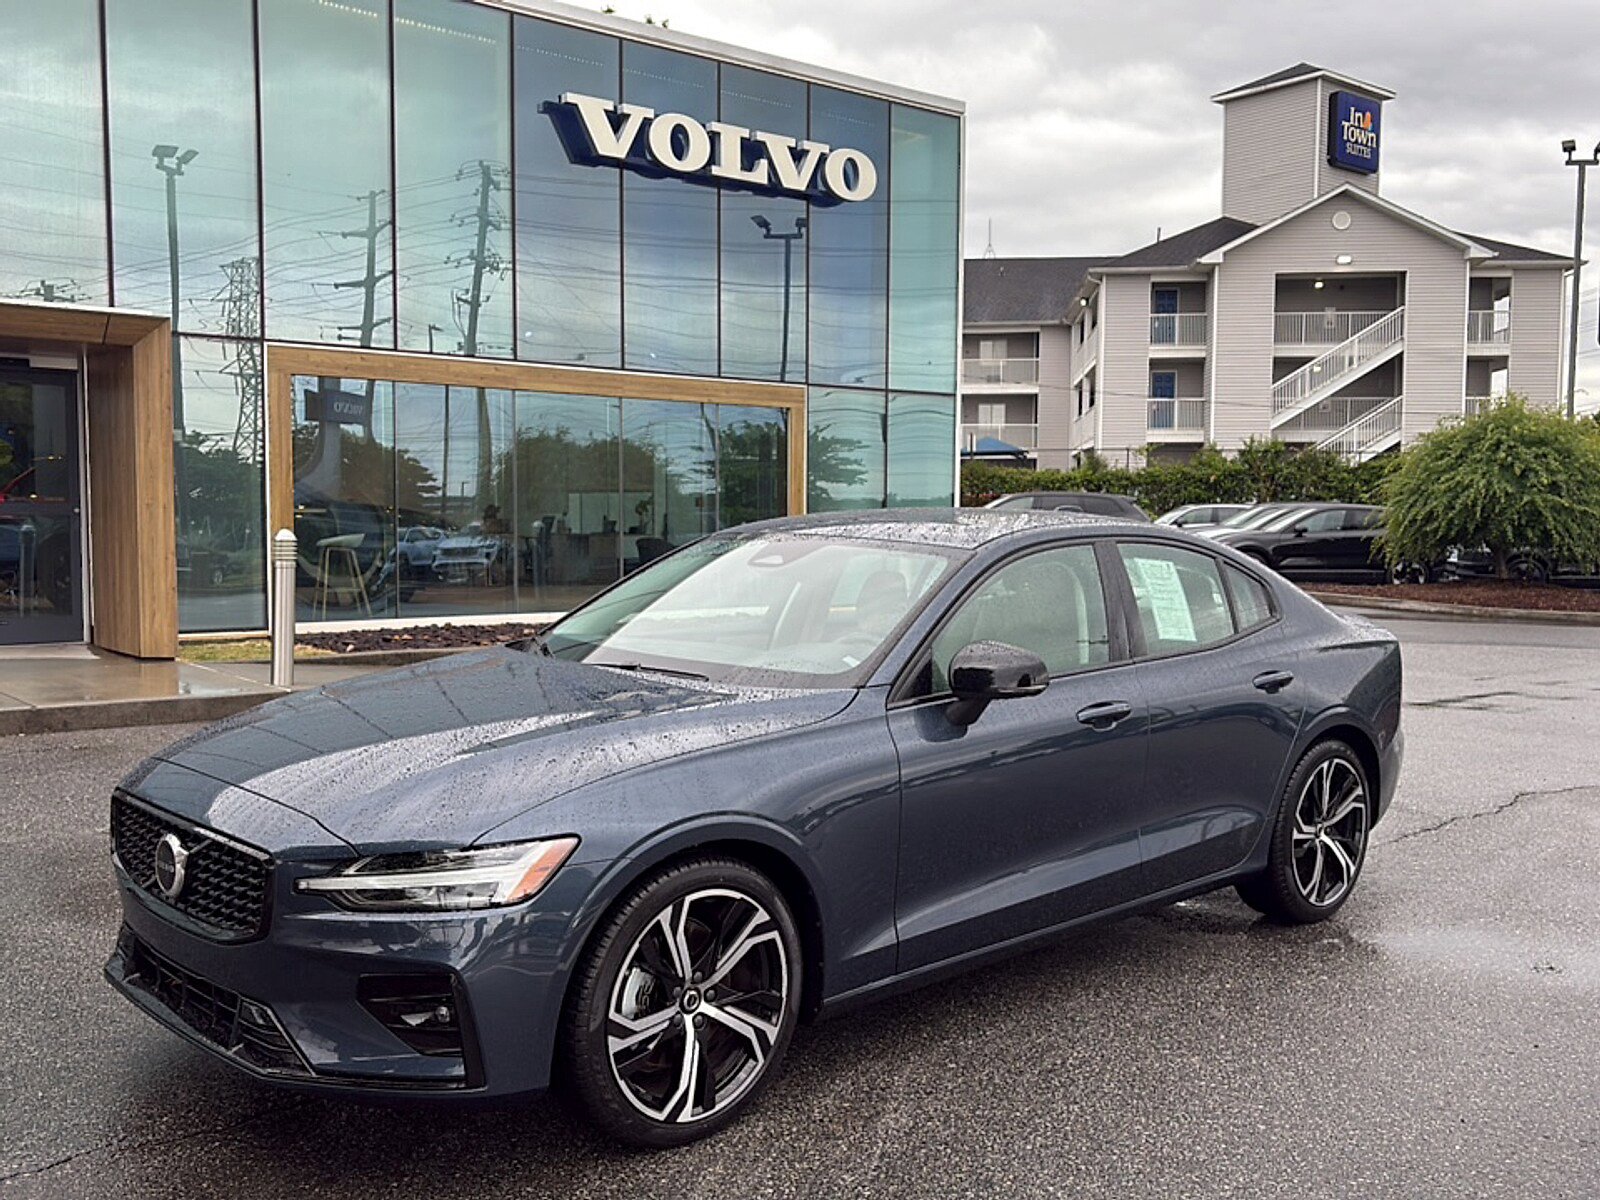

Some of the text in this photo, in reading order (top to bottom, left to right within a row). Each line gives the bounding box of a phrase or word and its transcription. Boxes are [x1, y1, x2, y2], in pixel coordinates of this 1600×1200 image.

[1350, 106, 1364, 127] In
[560, 91, 878, 201] VOLVO
[1341, 120, 1376, 148] Town
